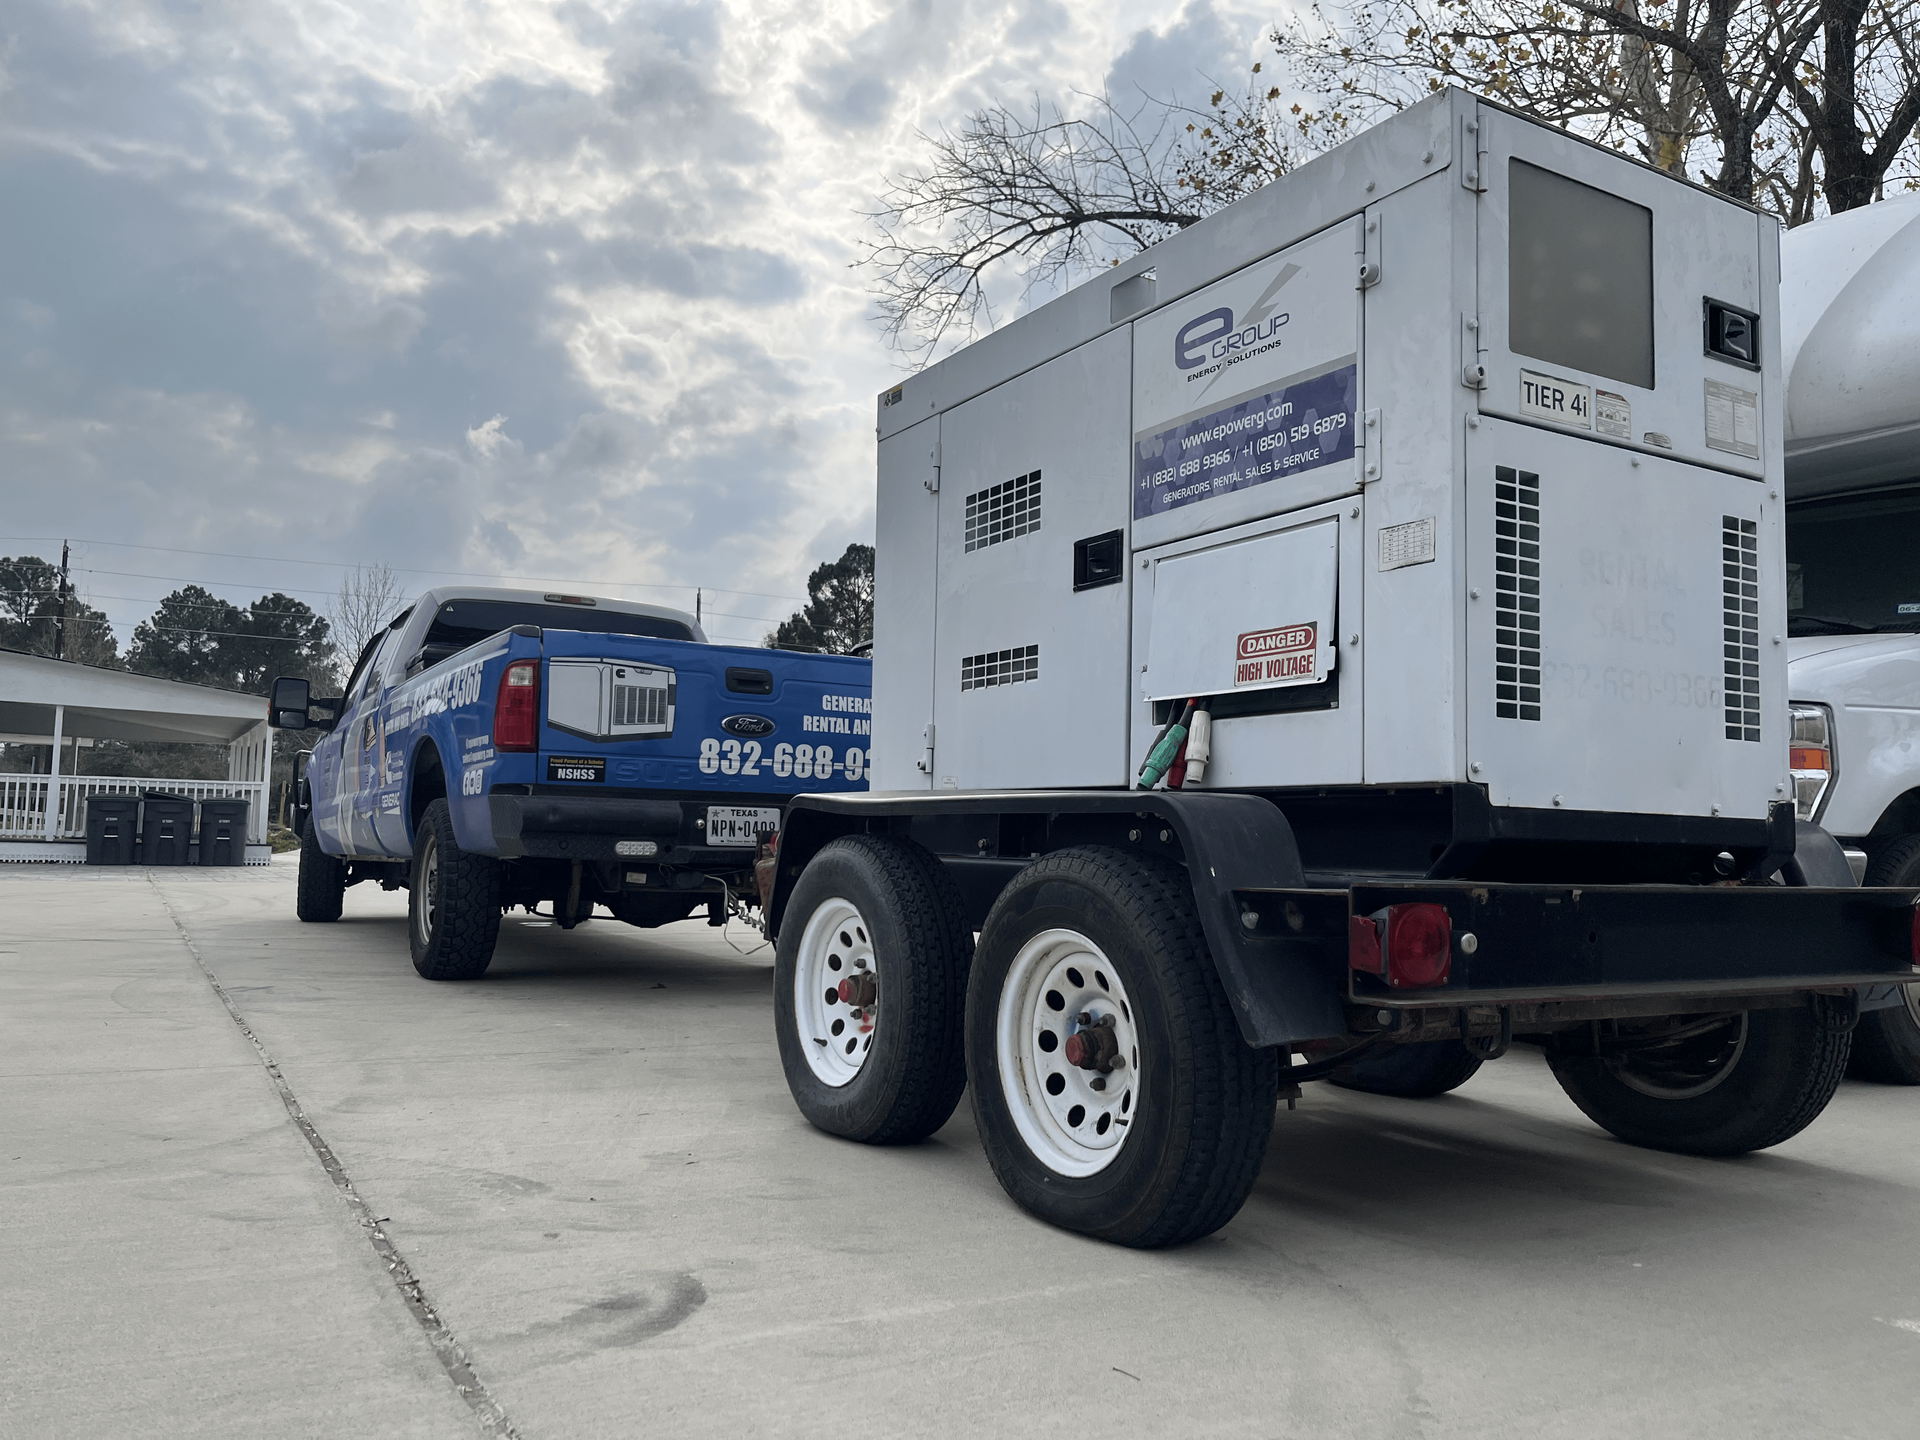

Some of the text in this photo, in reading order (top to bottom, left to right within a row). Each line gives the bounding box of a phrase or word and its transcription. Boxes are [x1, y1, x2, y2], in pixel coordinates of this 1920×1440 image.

[1212, 313, 1290, 358] GROUP
[1187, 340, 1282, 382] ENERGY SOLUTIONS
[1524, 381, 1564, 412] TIER
[1570, 394, 1587, 418] 4i
[1182, 402, 1293, 450] www.epowerg.com
[1141, 475, 1150, 490] +1
[1152, 466, 1176, 488] (832)
[1180, 458, 1200, 478] 688
[1203, 448, 1230, 471] 9366
[1242, 442, 1253, 457] +1
[1256, 431, 1287, 455] (850)
[1290, 424, 1310, 443] 519
[1314, 412, 1346, 436] 6879
[1246, 463, 1272, 479] SALES
[1274, 459, 1280, 470] &
[1284, 448, 1320, 468] SERVICE
[1247, 631, 1306, 652] DANGER
[1238, 654, 1314, 682] HIGH VOLTAGE
[822, 694, 872, 714] GENERA
[803, 715, 850, 734] RENTAL
[558, 768, 596, 780] NSHSS
